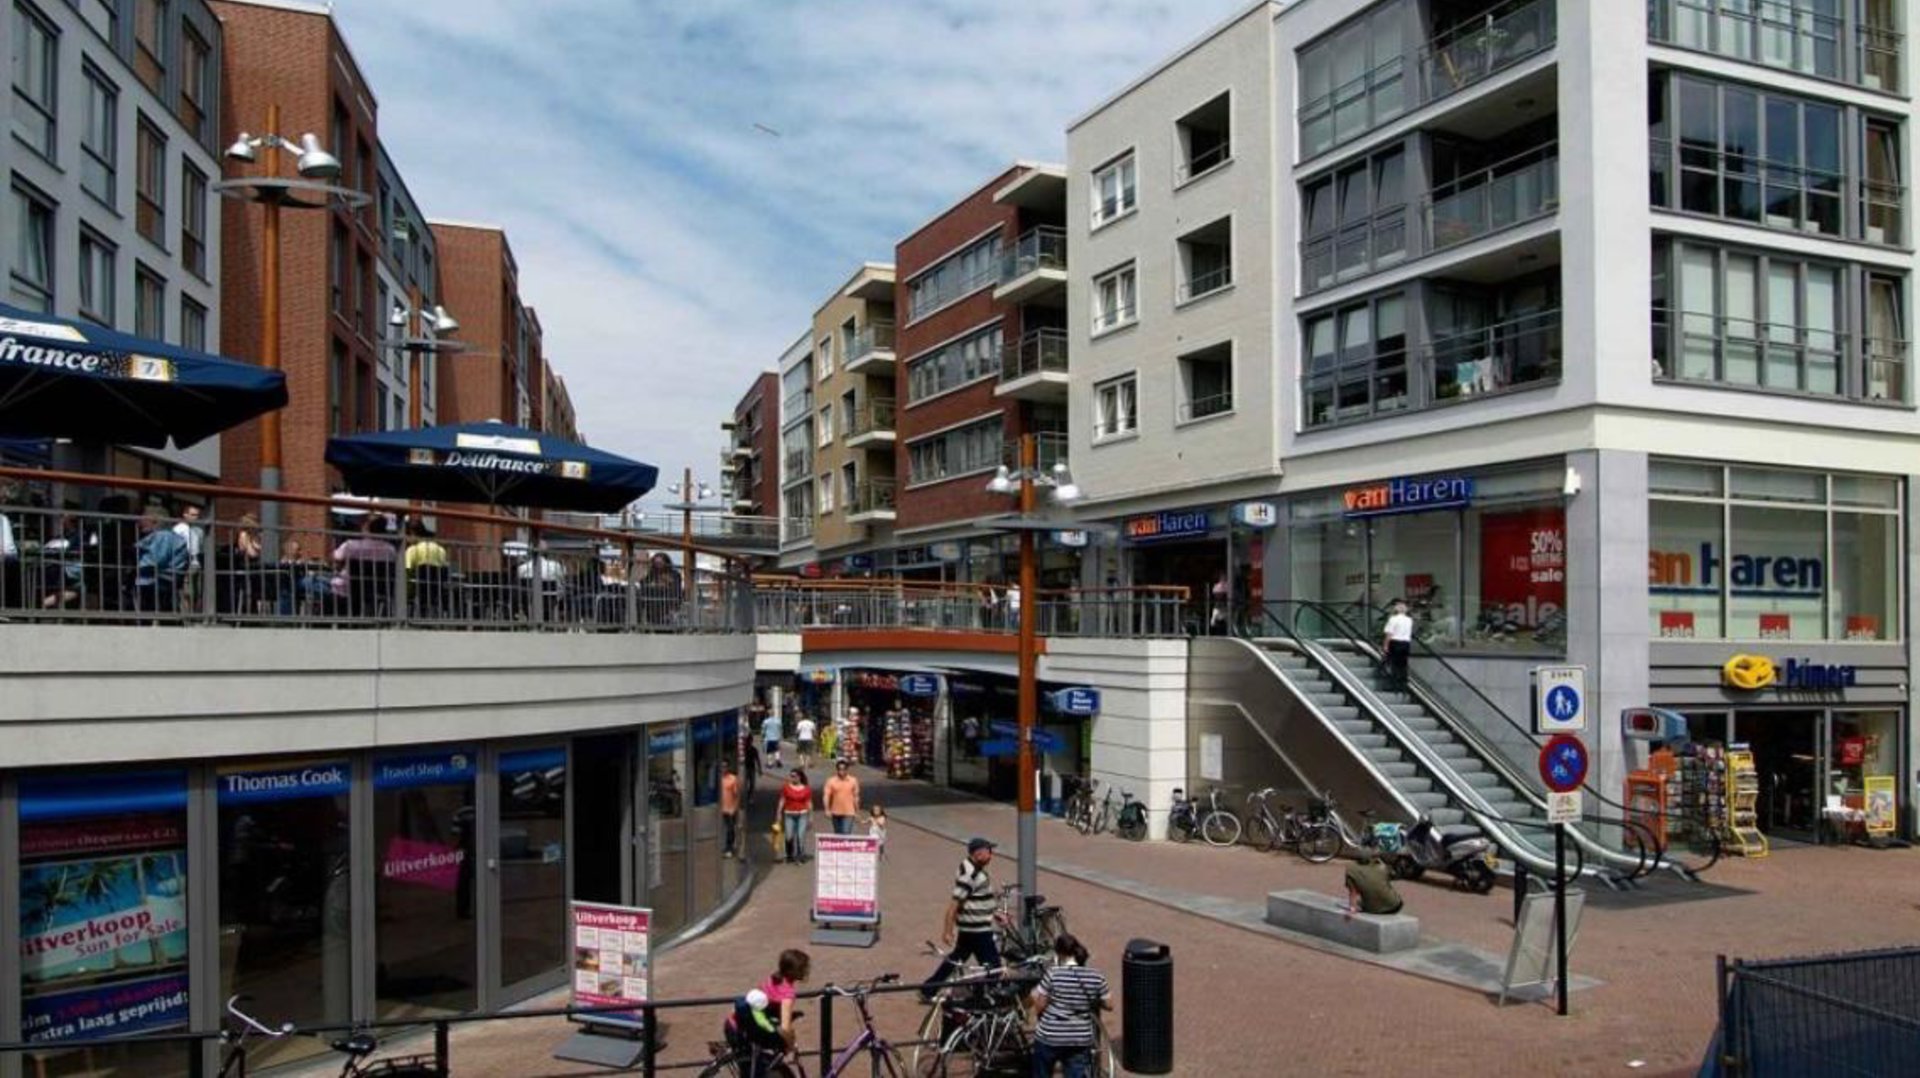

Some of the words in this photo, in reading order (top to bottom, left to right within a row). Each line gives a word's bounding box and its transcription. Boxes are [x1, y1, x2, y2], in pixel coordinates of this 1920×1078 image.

[1531, 530, 1563, 553] 50%
[1530, 567, 1563, 582] sale
[1700, 542, 1822, 588] Haren
[1785, 658, 1856, 688] Primera
[227, 772, 298, 793] Thomas
[302, 768, 342, 785] Cook
[382, 766, 416, 779] Travel
[418, 763, 444, 779] Shop
[383, 849, 464, 876] Uitverkoop
[75, 938, 109, 957] Sun
[113, 929, 142, 947] for
[79, 1013, 115, 1031] laag
[118, 991, 188, 1020] geprijsd!
